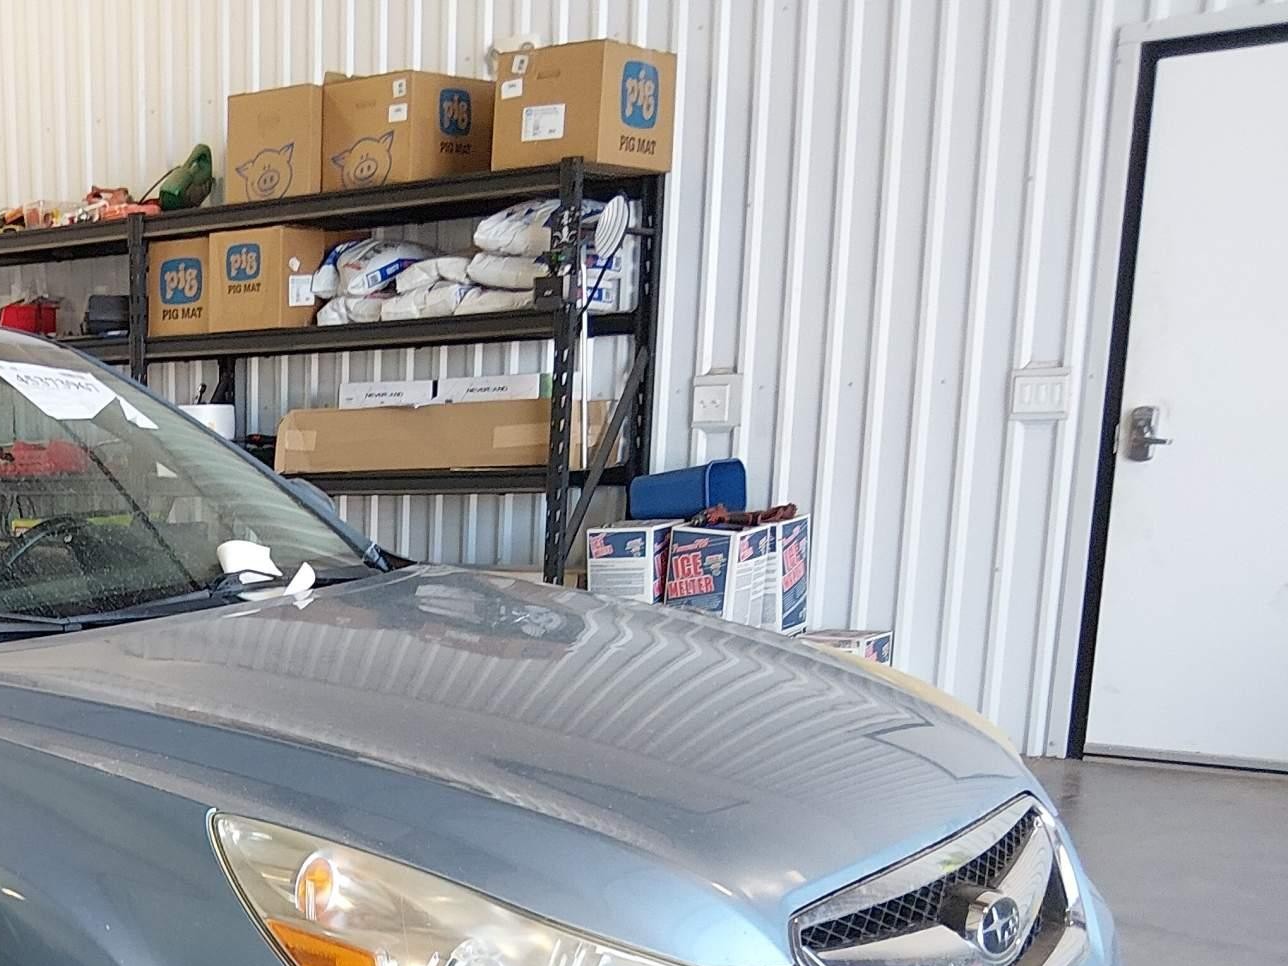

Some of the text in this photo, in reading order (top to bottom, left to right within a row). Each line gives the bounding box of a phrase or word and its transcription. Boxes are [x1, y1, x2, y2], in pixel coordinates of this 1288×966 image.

[625, 69, 655, 121] pig
[619, 135, 657, 156] PIG MAT
[229, 247, 257, 278] pig
[164, 262, 199, 300] pig
[227, 282, 261, 295] PIG MAT
[162, 306, 204, 321] PIG MAT
[672, 551, 704, 580] ICE
[668, 574, 715, 599] MELTER
